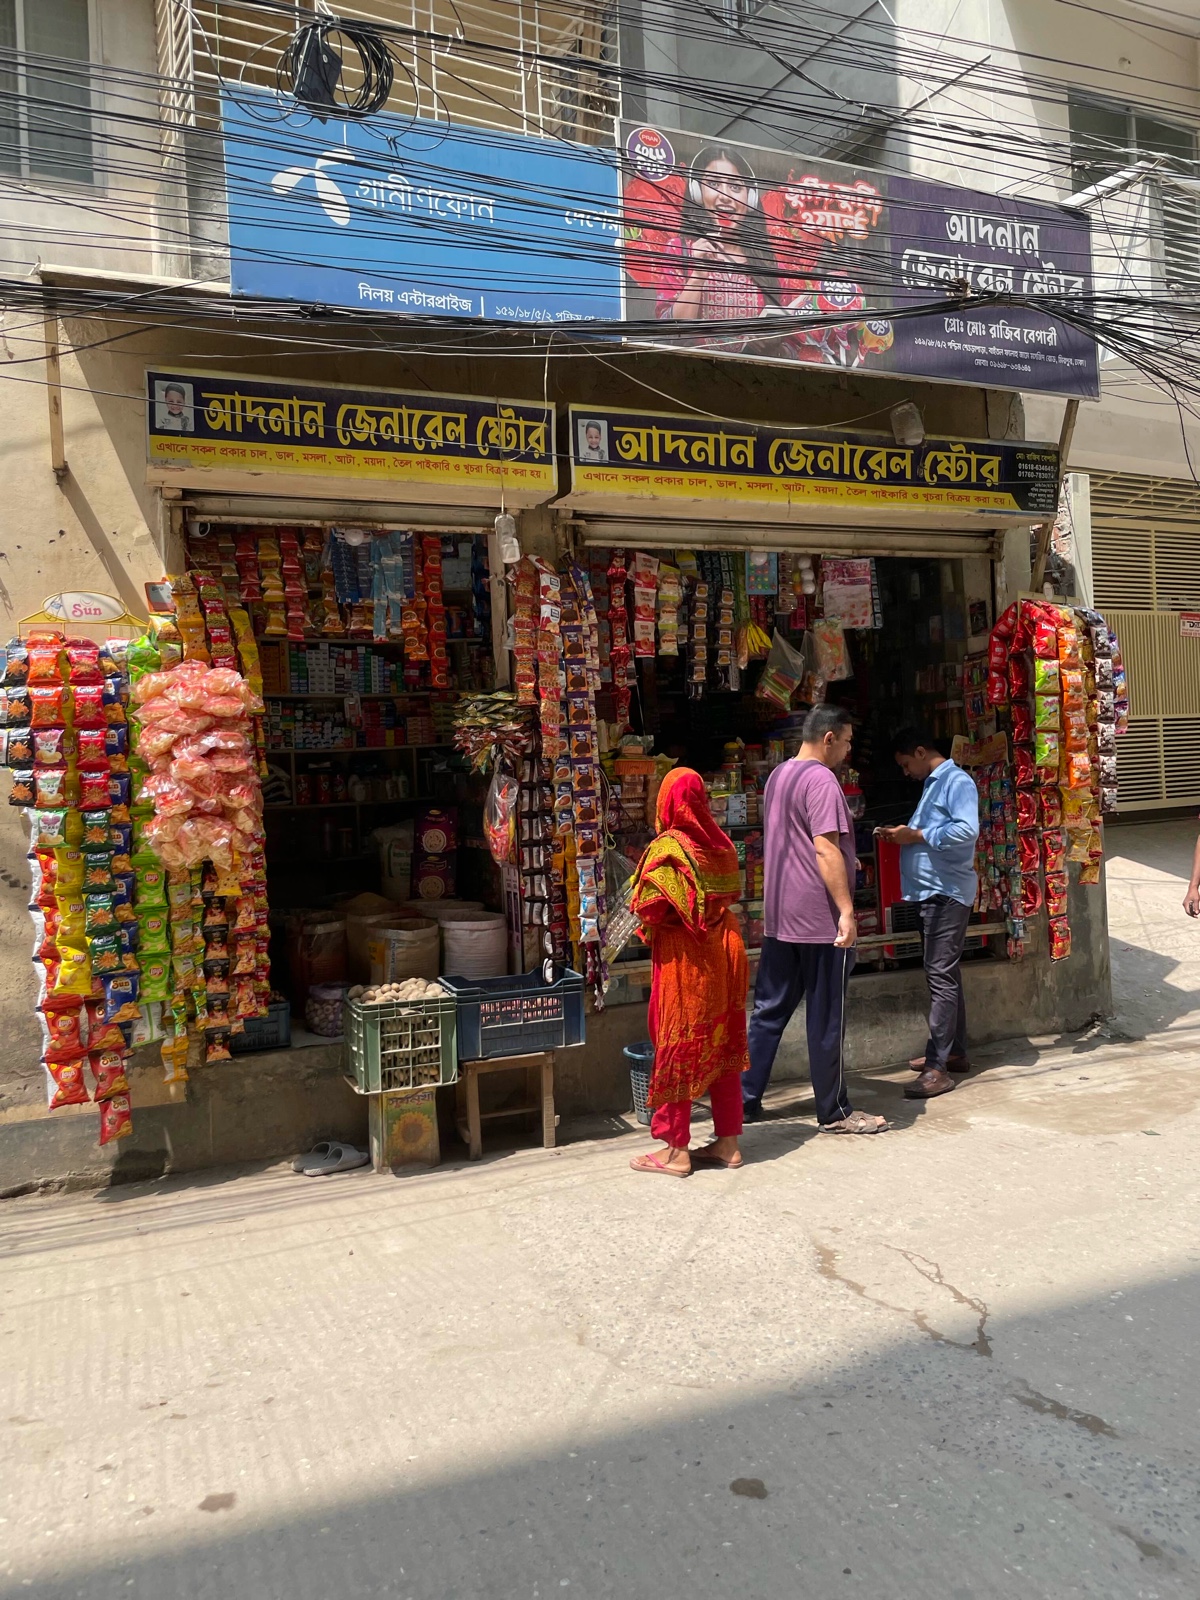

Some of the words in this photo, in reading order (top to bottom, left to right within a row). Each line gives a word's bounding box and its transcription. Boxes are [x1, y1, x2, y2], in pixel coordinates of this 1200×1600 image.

[634, 143, 667, 160] LOLLI
[641, 134, 659, 142] PRAN
[356, 174, 496, 224] গ্রামীণফোন
[944, 209, 1041, 258] আদনান
[358, 282, 395, 302] নিলয়
[397, 288, 472, 314] এন্টারপ্রাইজ
[495, 305, 553, 323] ১৫৯/১৮/৫/২
[944, 316, 964, 333] প্রোঃ
[967, 320, 986, 336] মোঃ
[988, 320, 1021, 342] রাজিব
[1023, 326, 1057, 346] বেপারী
[202, 391, 326, 438] আদনান
[336, 403, 467, 452] জেনারেল
[477, 405, 549, 459] ষ্টোর
[156, 442, 188, 454] এখানে
[191, 444, 216, 455] সকল
[219, 446, 247, 458] প্রকার
[393, 456, 412, 469] তৈল
[415, 459, 450, 471] পাইকারি
[463, 464, 483, 475] খুচরা
[485, 463, 509, 475] বিক্রয়
[511, 468, 527, 477] করা
[613, 425, 756, 469] আদনান
[768, 440, 915, 482] জেনারেল
[922, 441, 1002, 487] ষ্টোর
[583, 472, 618, 482] এখানে
[622, 474, 650, 484] সকল
[654, 475, 684, 487] প্রকার
[846, 485, 867, 497] তৈল
[871, 488, 908, 500] পাইকারি
[911, 492, 919, 500] ও
[923, 492, 943, 503] খুচরা
[946, 492, 971, 503] বিক্রয়
[974, 496, 990, 505] করা
[71, 603, 103, 617] Sun
[111, 980, 130, 990] Sun
[101, 1055, 119, 1066] Sun
[113, 1099, 127, 1109] Sun
